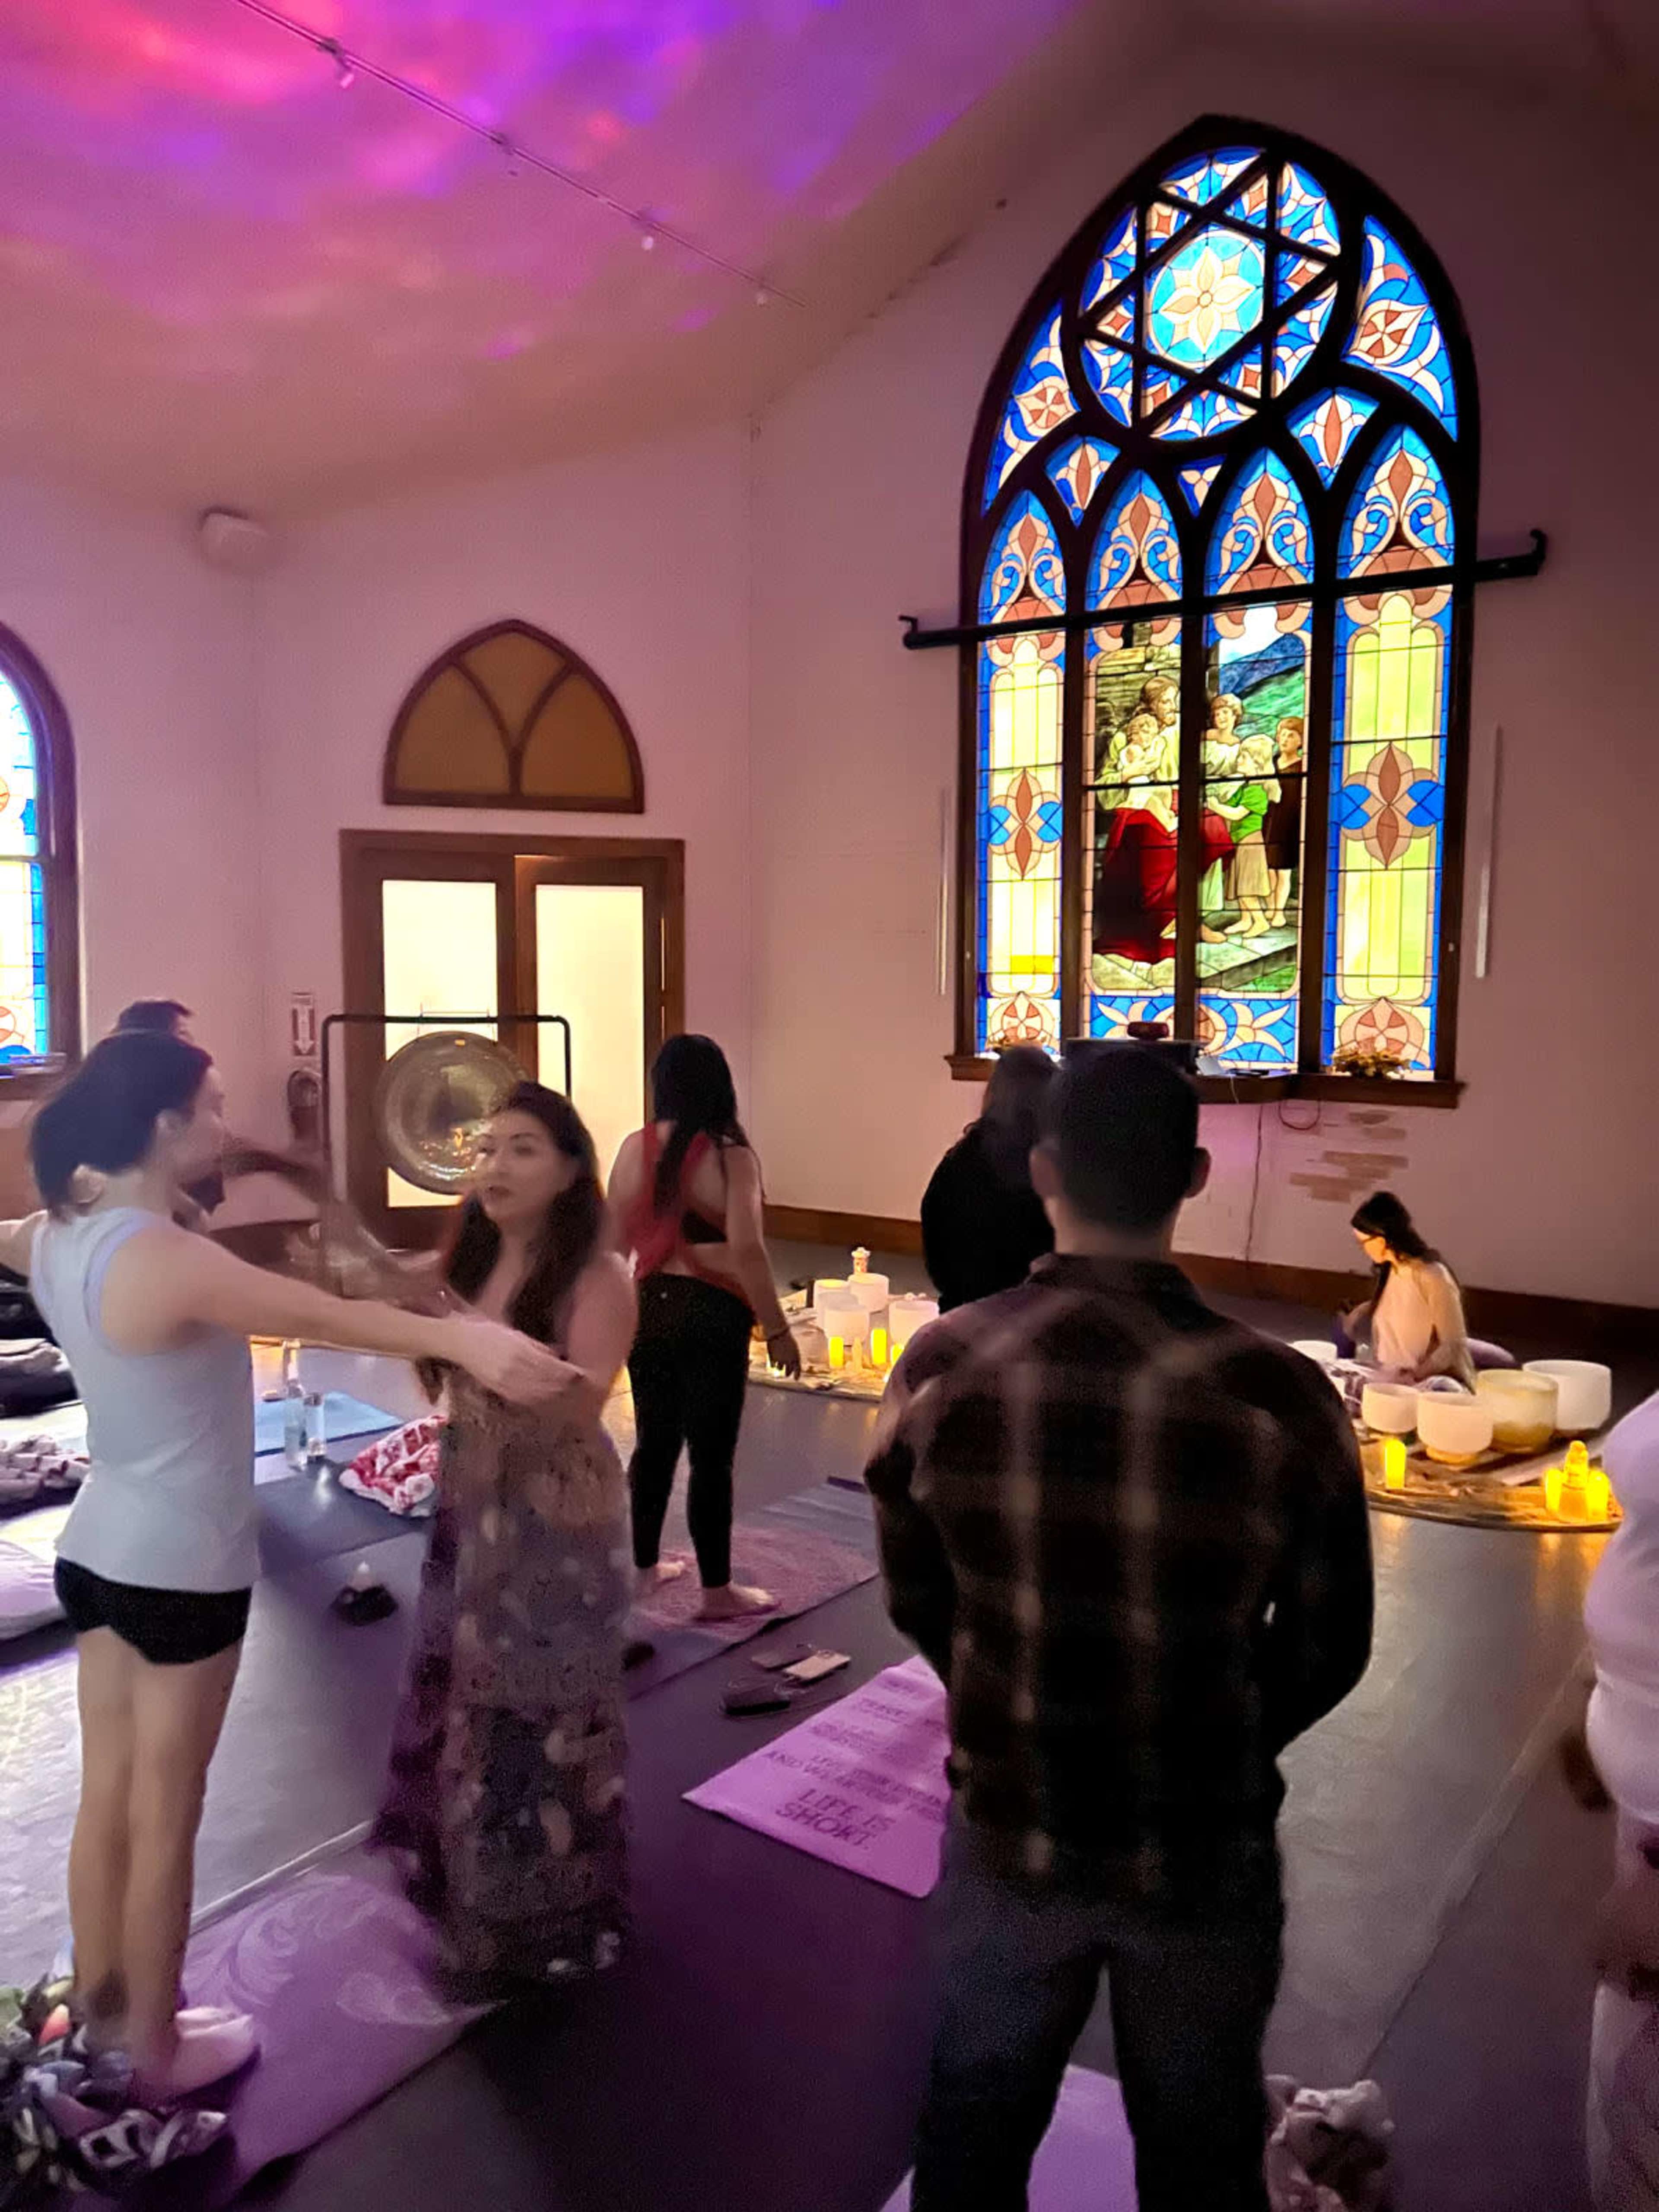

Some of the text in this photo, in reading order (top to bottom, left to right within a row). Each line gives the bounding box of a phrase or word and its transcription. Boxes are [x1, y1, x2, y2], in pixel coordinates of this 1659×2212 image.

[776, 1802, 877, 1850] SHORT.
[798, 1789, 864, 1820] LIFE
[863, 1814, 896, 1831] IS
